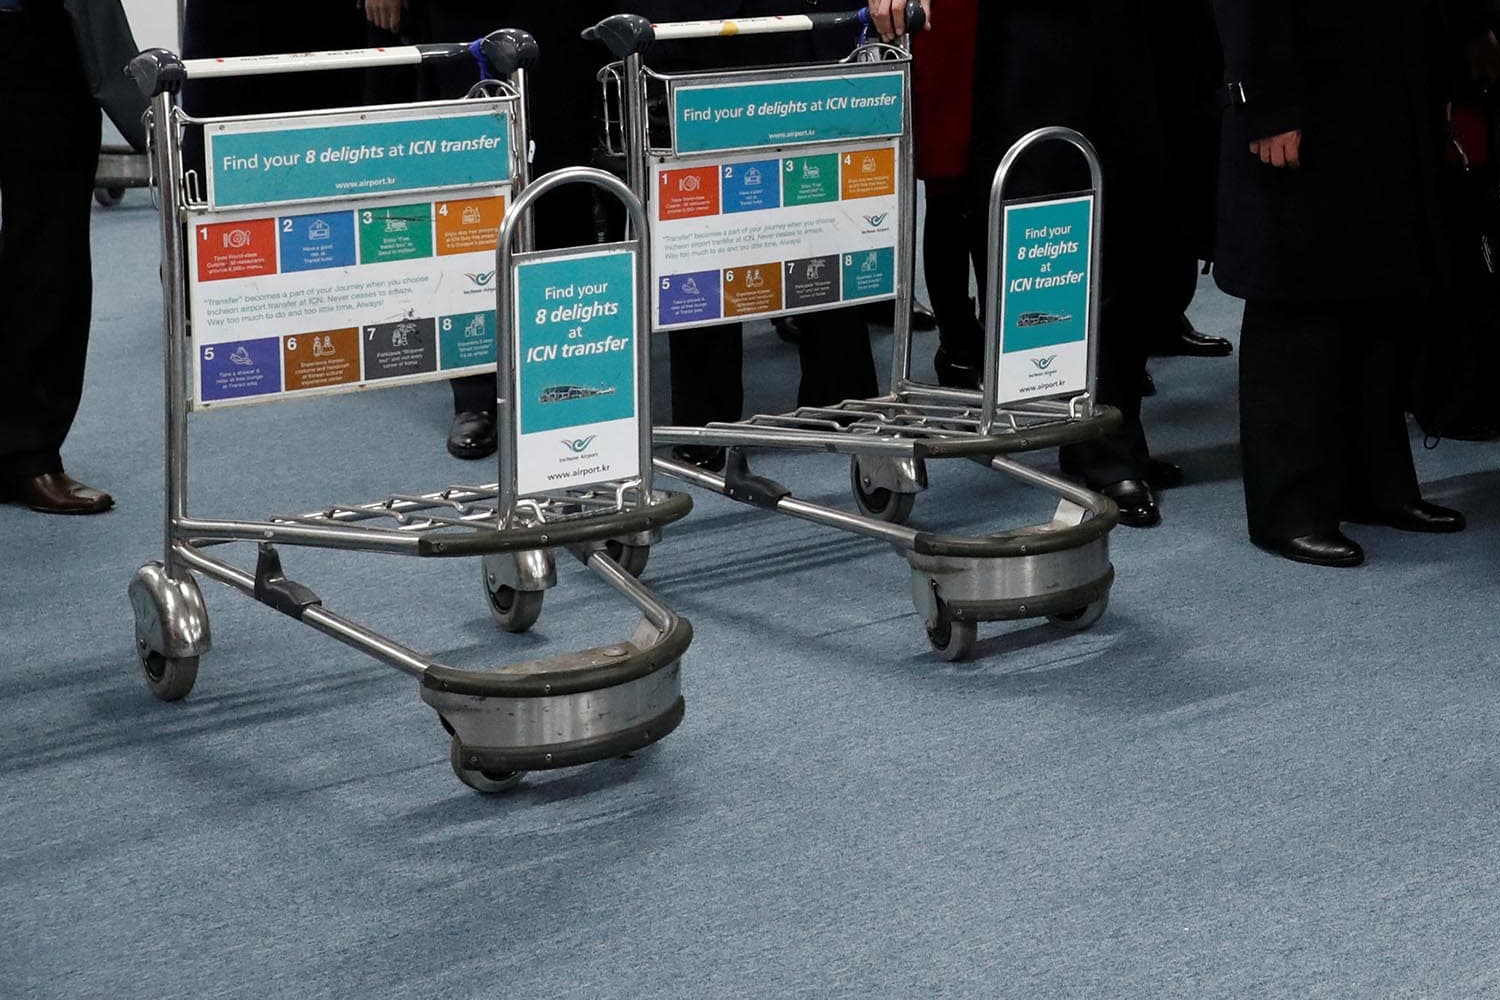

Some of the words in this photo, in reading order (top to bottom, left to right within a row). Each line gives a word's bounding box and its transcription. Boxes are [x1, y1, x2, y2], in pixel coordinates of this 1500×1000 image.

[684, 107, 711, 121] Find
[715, 107, 743, 122] your
[746, 104, 755, 117] 8
[758, 99, 807, 118] delights
[810, 100, 822, 112] at
[826, 97, 847, 110] ICN
[850, 93, 896, 108] transfer
[224, 155, 258, 170] Find
[263, 154, 301, 171] your
[305, 150, 316, 163] 8
[320, 141, 384, 164] delights
[388, 143, 404, 157] at
[408, 139, 437, 155] ICN
[440, 135, 500, 152] transfer
[785, 160, 794, 172] 3
[844, 154, 852, 166] 4
[662, 173, 668, 184] 1
[725, 167, 733, 178] 2
[335, 176, 396, 190] www.airport.kr
[439, 203, 449, 216] 4
[363, 211, 373, 224] 3
[283, 219, 293, 232] 2
[1025, 226, 1047, 239] Find
[1049, 224, 1072, 239] your
[200, 227, 208, 240] 1
[1017, 247, 1026, 260] 8
[1028, 241, 1079, 260] delights
[845, 254, 853, 266] 8
[787, 262, 795, 275] 7
[1040, 262, 1052, 273] at
[725, 270, 734, 282] 6
[1010, 277, 1033, 293] ICN
[1035, 271, 1084, 289] transfer
[545, 284, 574, 300] Find
[577, 281, 608, 300] your
[662, 278, 671, 290] 5
[535, 308, 547, 324] 8
[550, 301, 619, 324] delights
[443, 318, 453, 331] 8
[367, 327, 376, 340] 7
[568, 326, 583, 339] at
[287, 337, 297, 350] 6
[526, 344, 558, 363] ICN
[562, 336, 628, 358] transfer
[204, 347, 215, 360] 5
[1019, 379, 1066, 394] www.airport.kr
[547, 463, 610, 481] www.airport.kr
